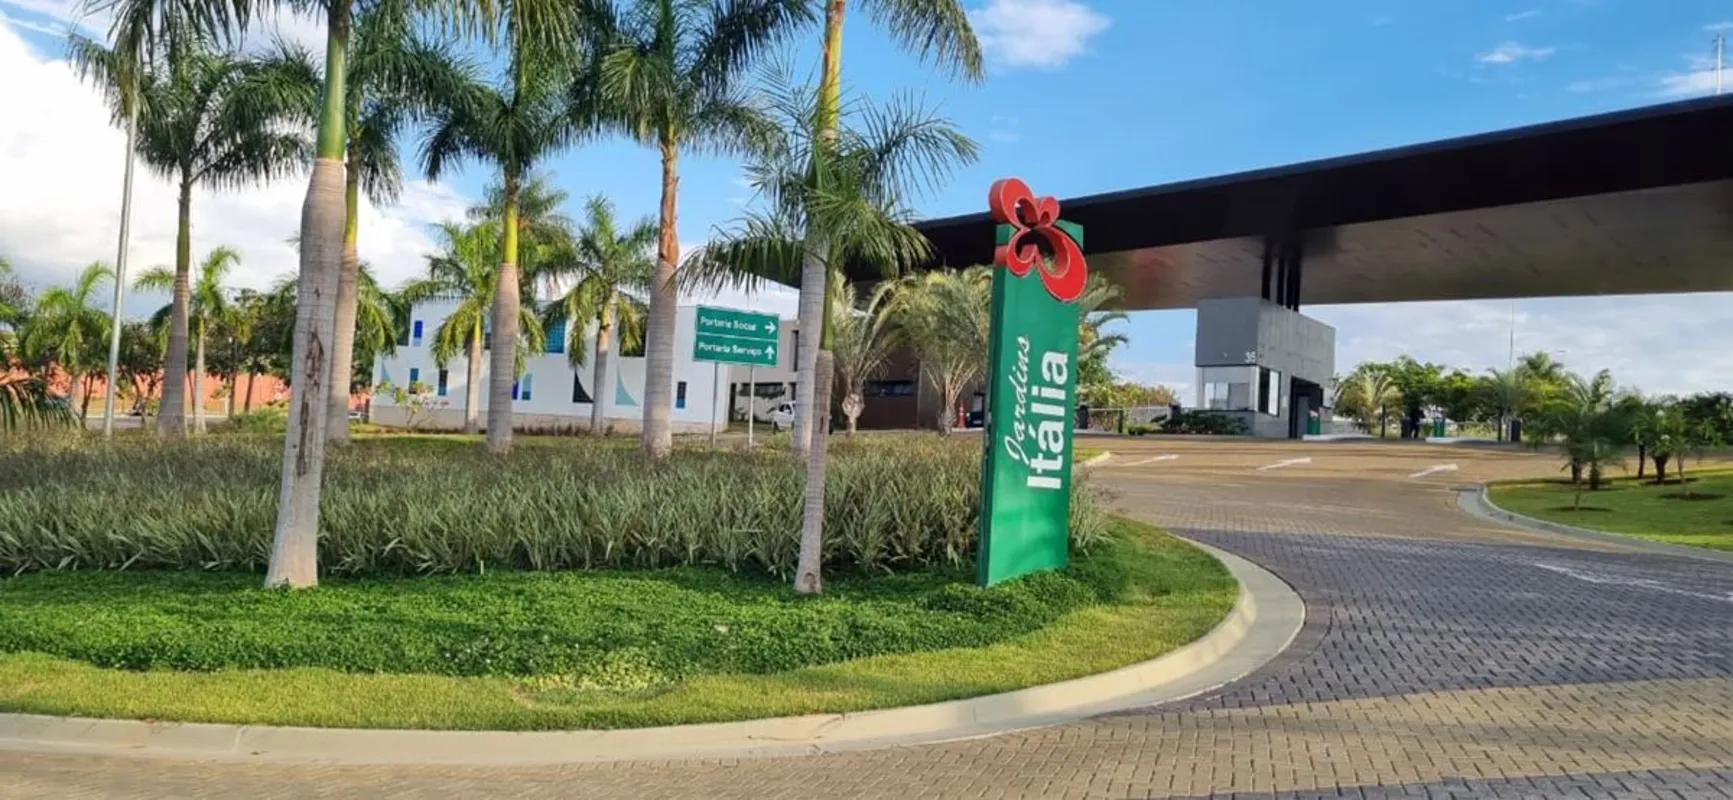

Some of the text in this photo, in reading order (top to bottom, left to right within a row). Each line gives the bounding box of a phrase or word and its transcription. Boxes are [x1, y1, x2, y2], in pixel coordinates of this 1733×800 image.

[698, 341, 762, 357] Portaria Serviço
[700, 316, 757, 331] Portaria Social
[1004, 335, 1030, 466] Jardins
[1026, 350, 1069, 490] Itália
